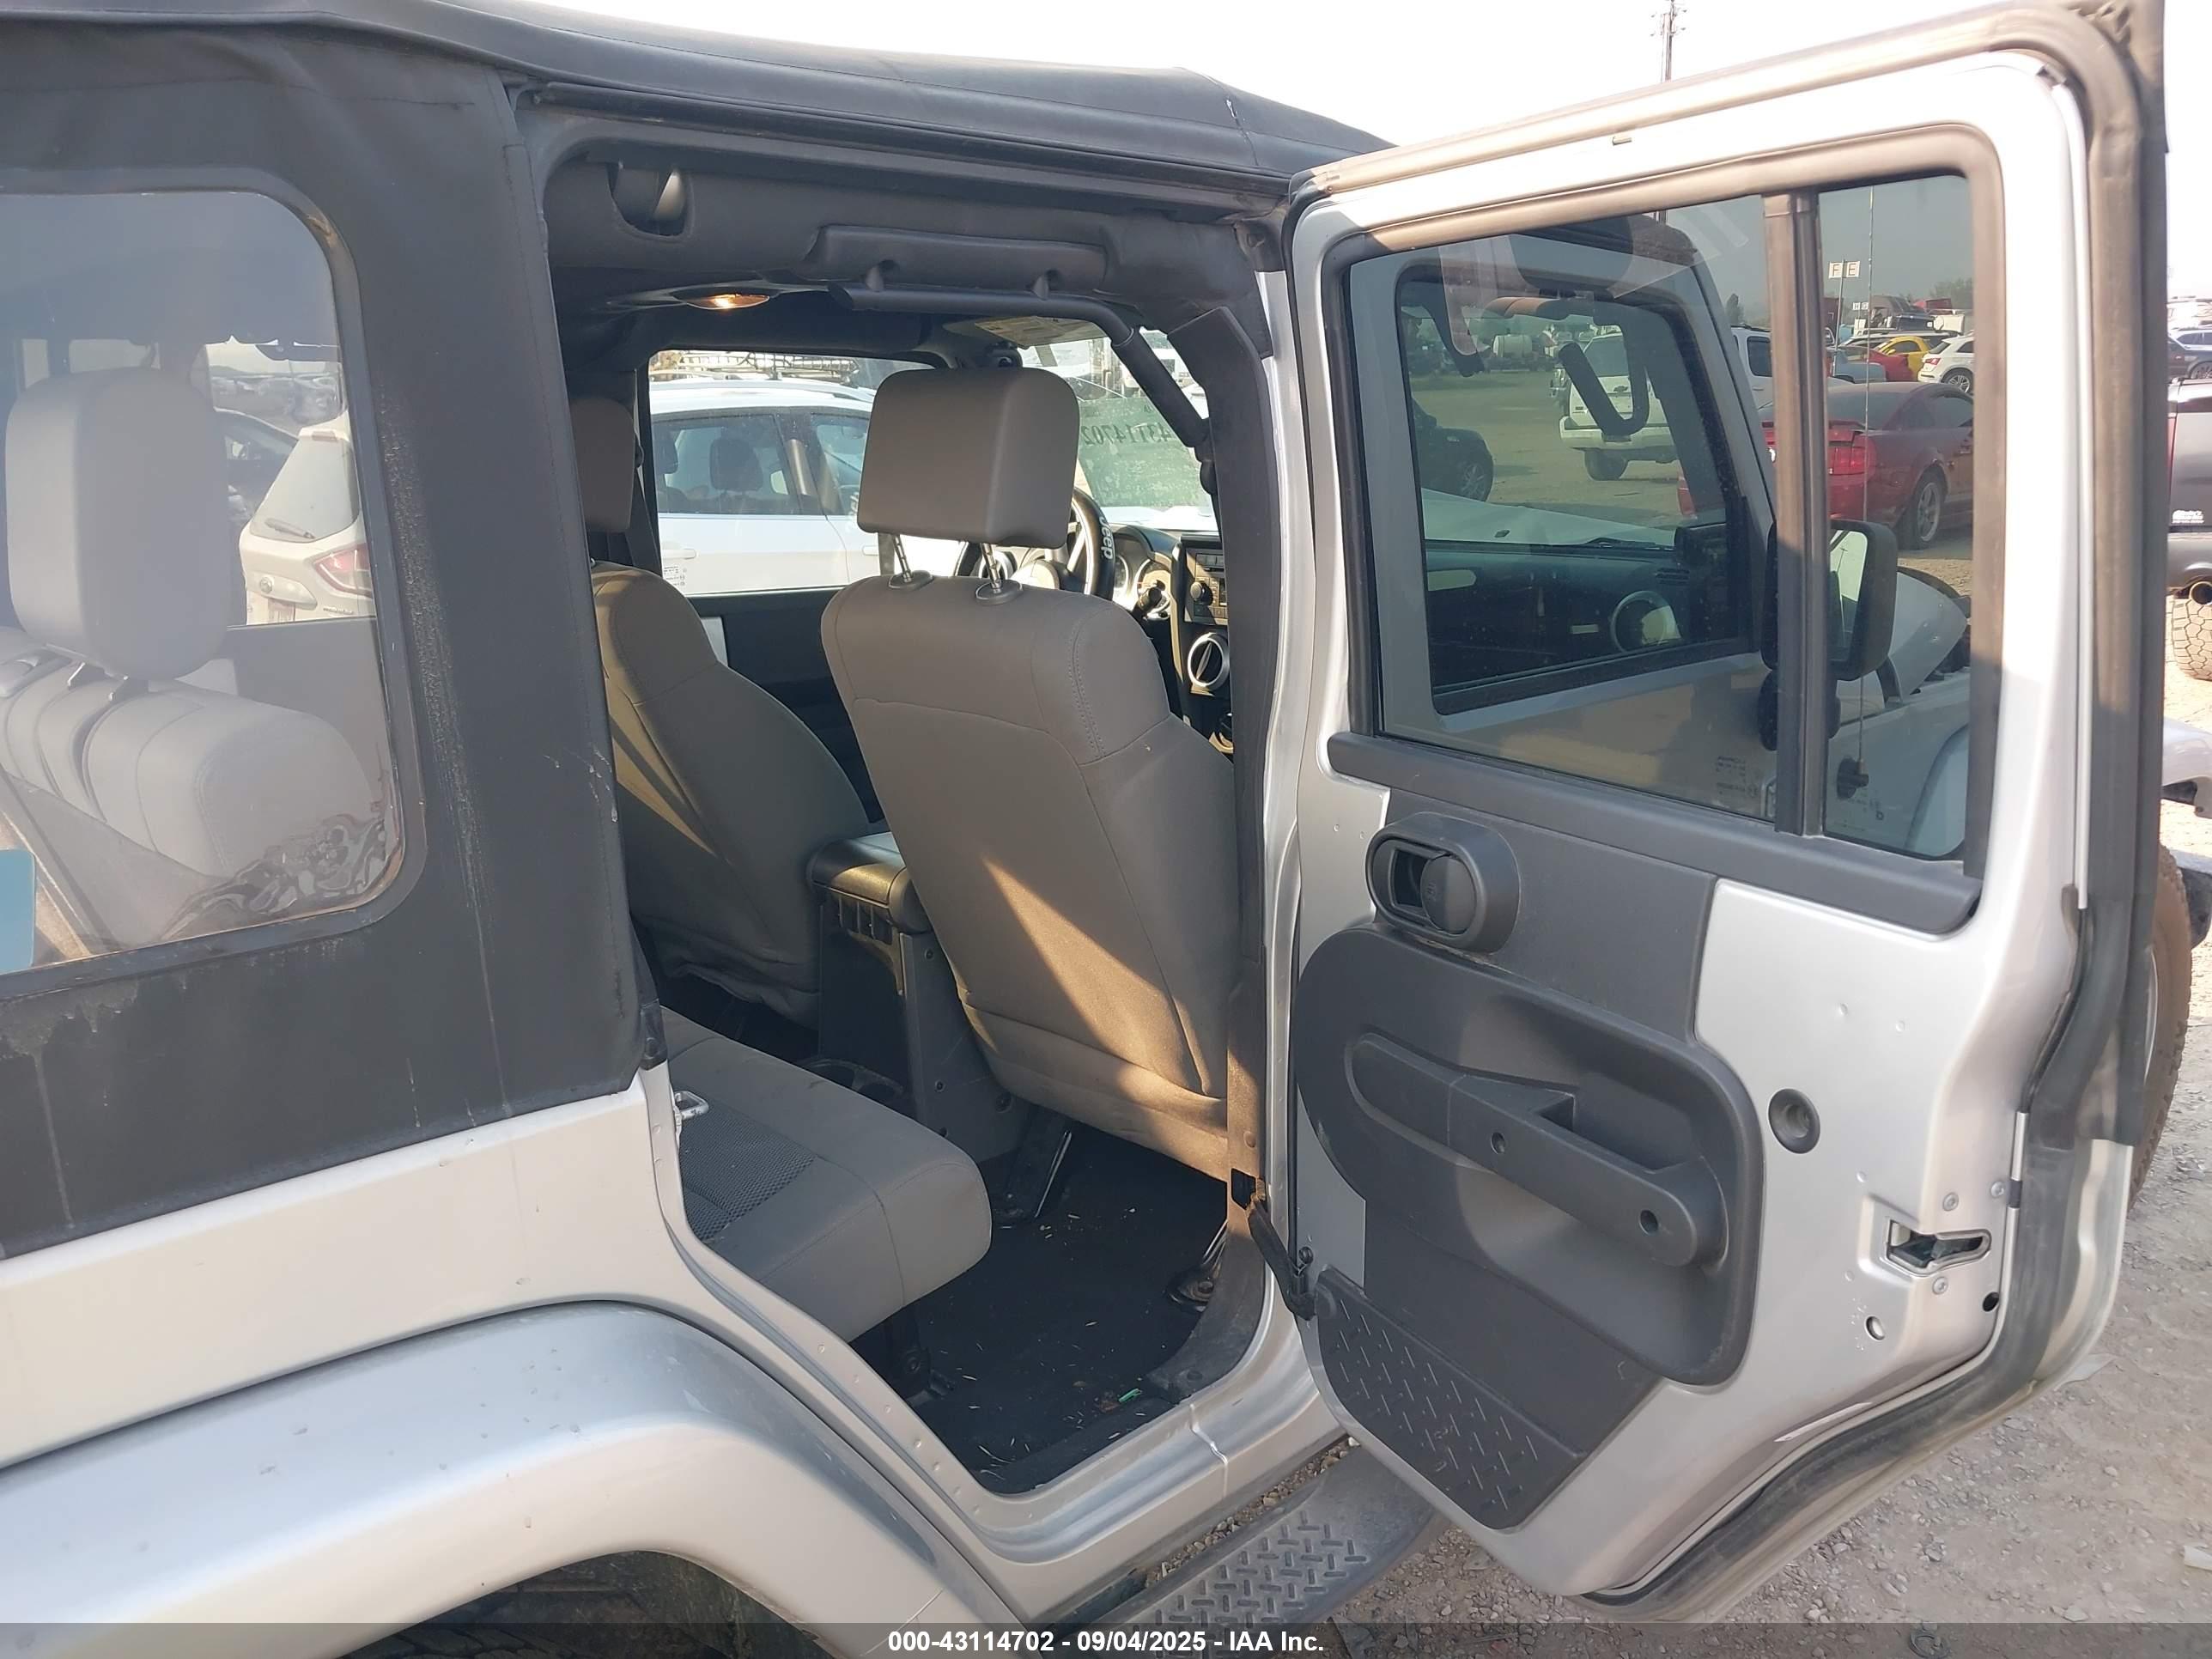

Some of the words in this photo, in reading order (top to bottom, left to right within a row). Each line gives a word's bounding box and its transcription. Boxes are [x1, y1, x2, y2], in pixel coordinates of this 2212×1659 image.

[1832, 264, 1840, 276] F
[1848, 263, 1856, 276] E
[1098, 516, 1114, 560] Jeep
